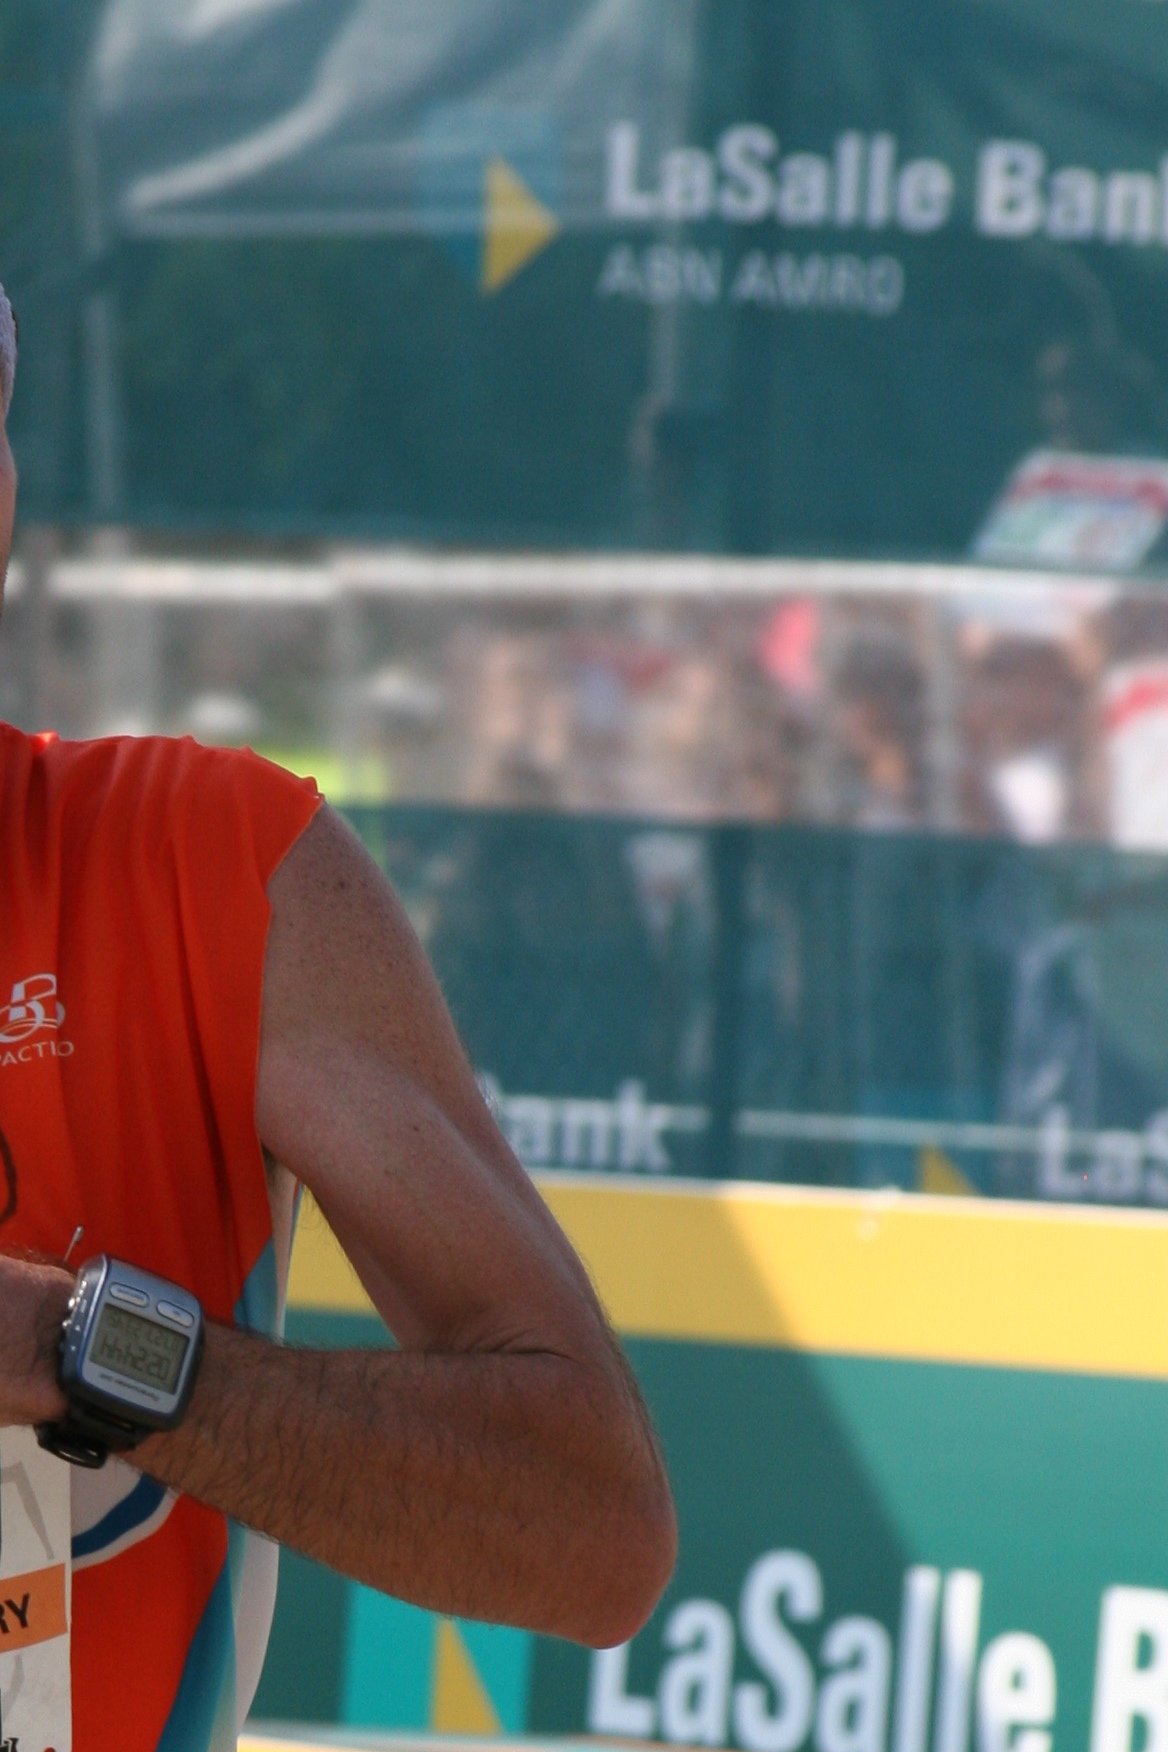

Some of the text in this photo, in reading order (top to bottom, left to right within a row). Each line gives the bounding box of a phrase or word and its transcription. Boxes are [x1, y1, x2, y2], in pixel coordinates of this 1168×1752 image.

[607, 120, 1168, 248] LaSalle Ban
[598, 246, 906, 315] ABN AMRO
[480, 1076, 673, 1173] ank
